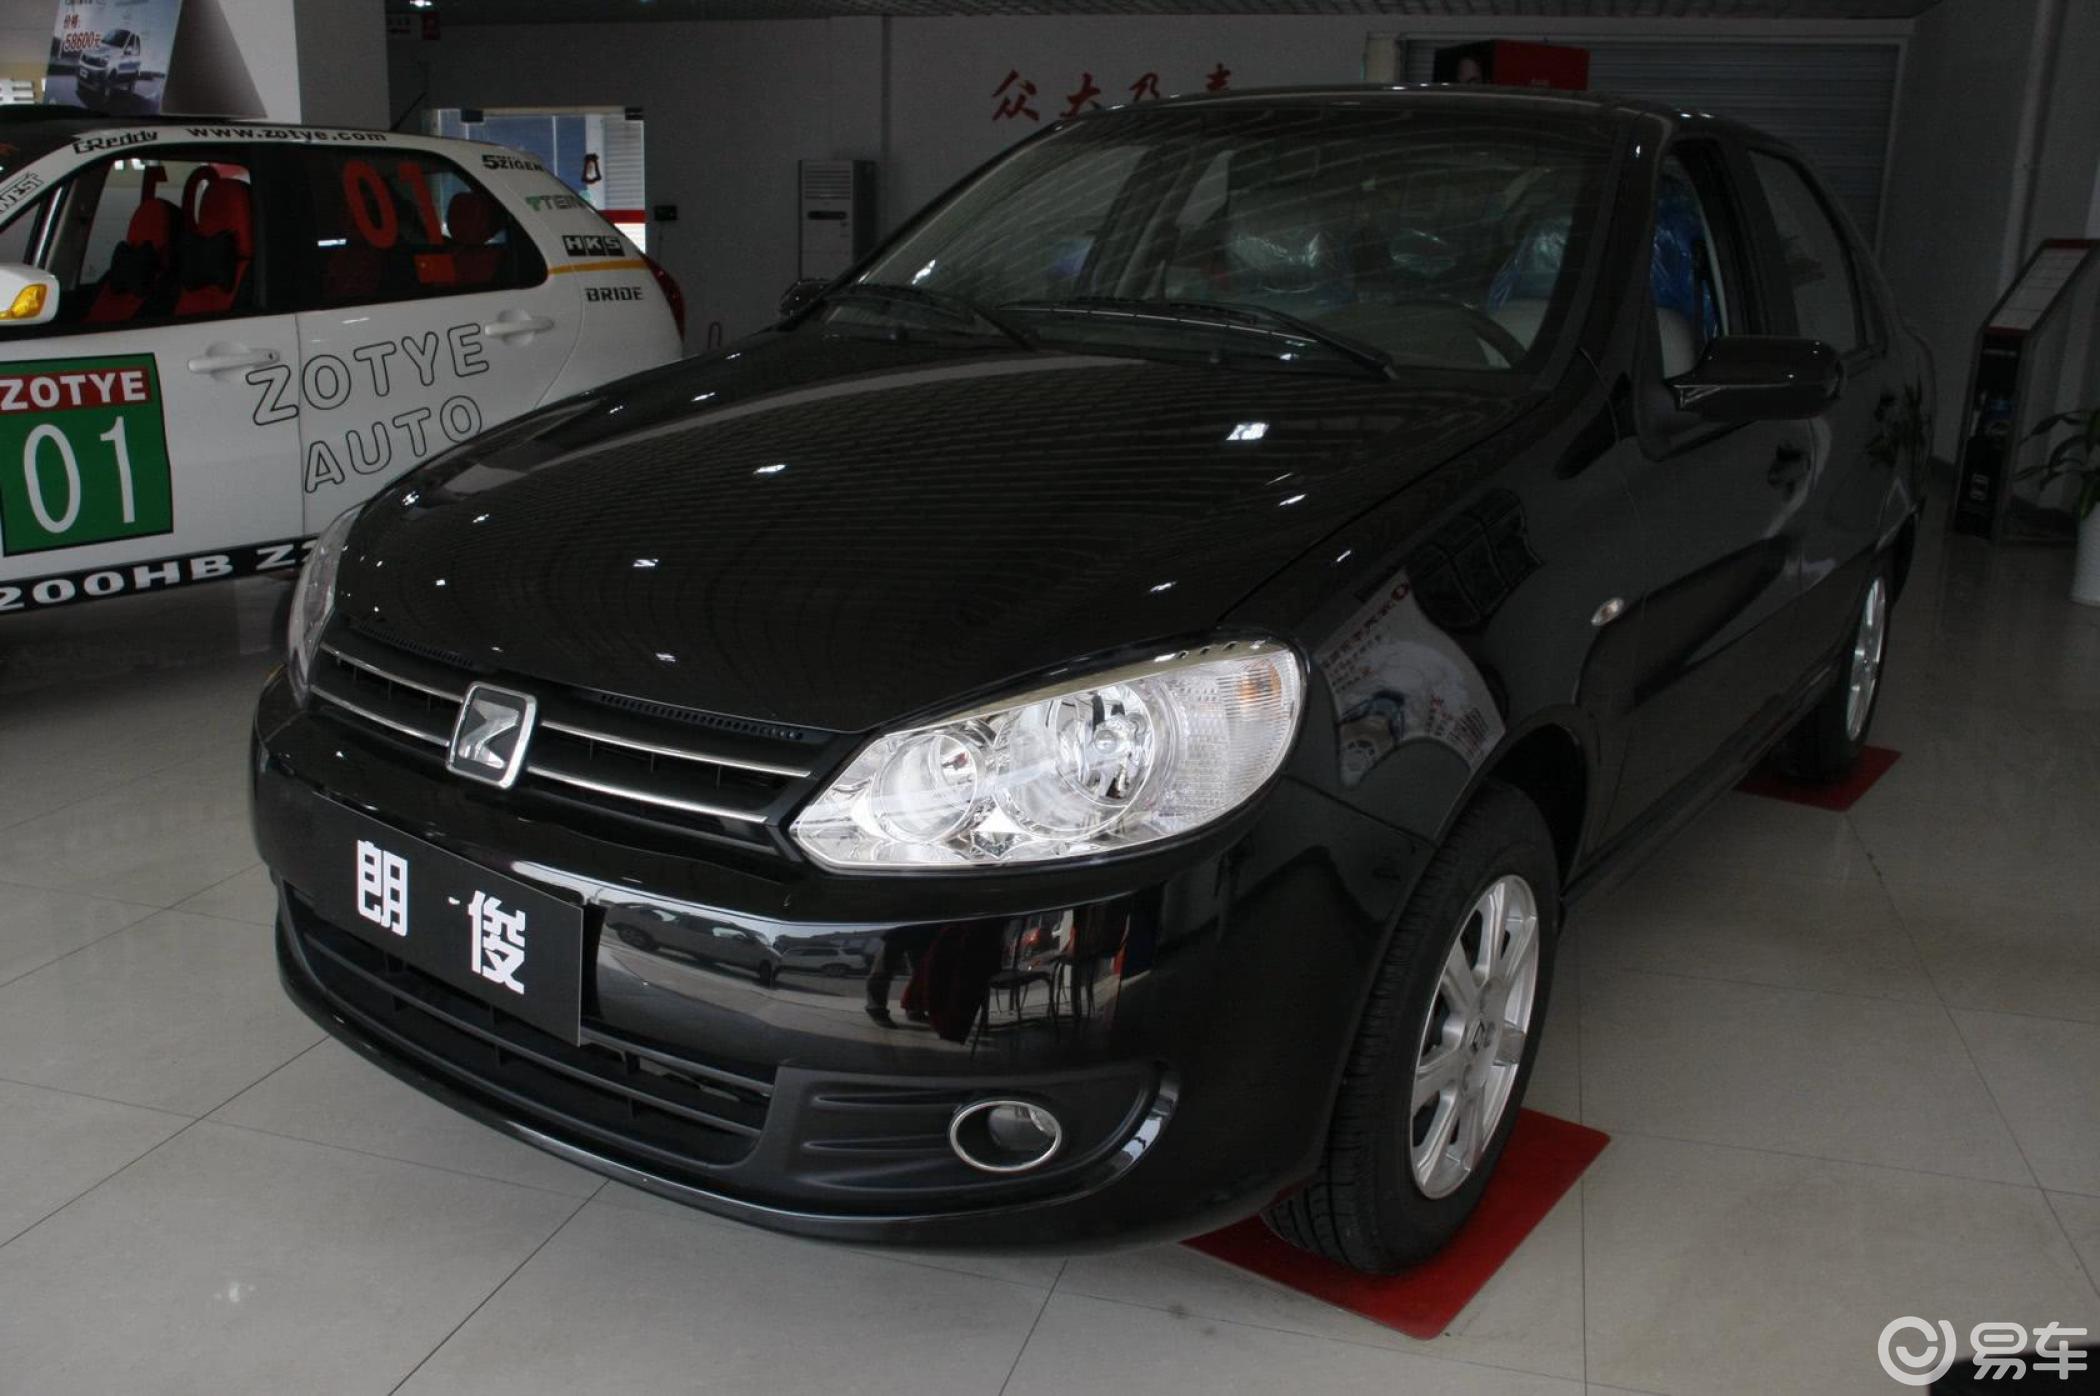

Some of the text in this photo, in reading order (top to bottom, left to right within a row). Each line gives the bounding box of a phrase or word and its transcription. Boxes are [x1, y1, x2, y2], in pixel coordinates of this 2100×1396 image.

[187, 128, 387, 143] www.zotye.com
[343, 159, 445, 250] 01
[563, 236, 623, 252] HKS
[584, 286, 644, 302] BRIDE
[0, 371, 146, 411] ZOTYE
[245, 323, 490, 426] ZOTYE
[24, 416, 136, 533] 01
[304, 395, 482, 494] AUTO
